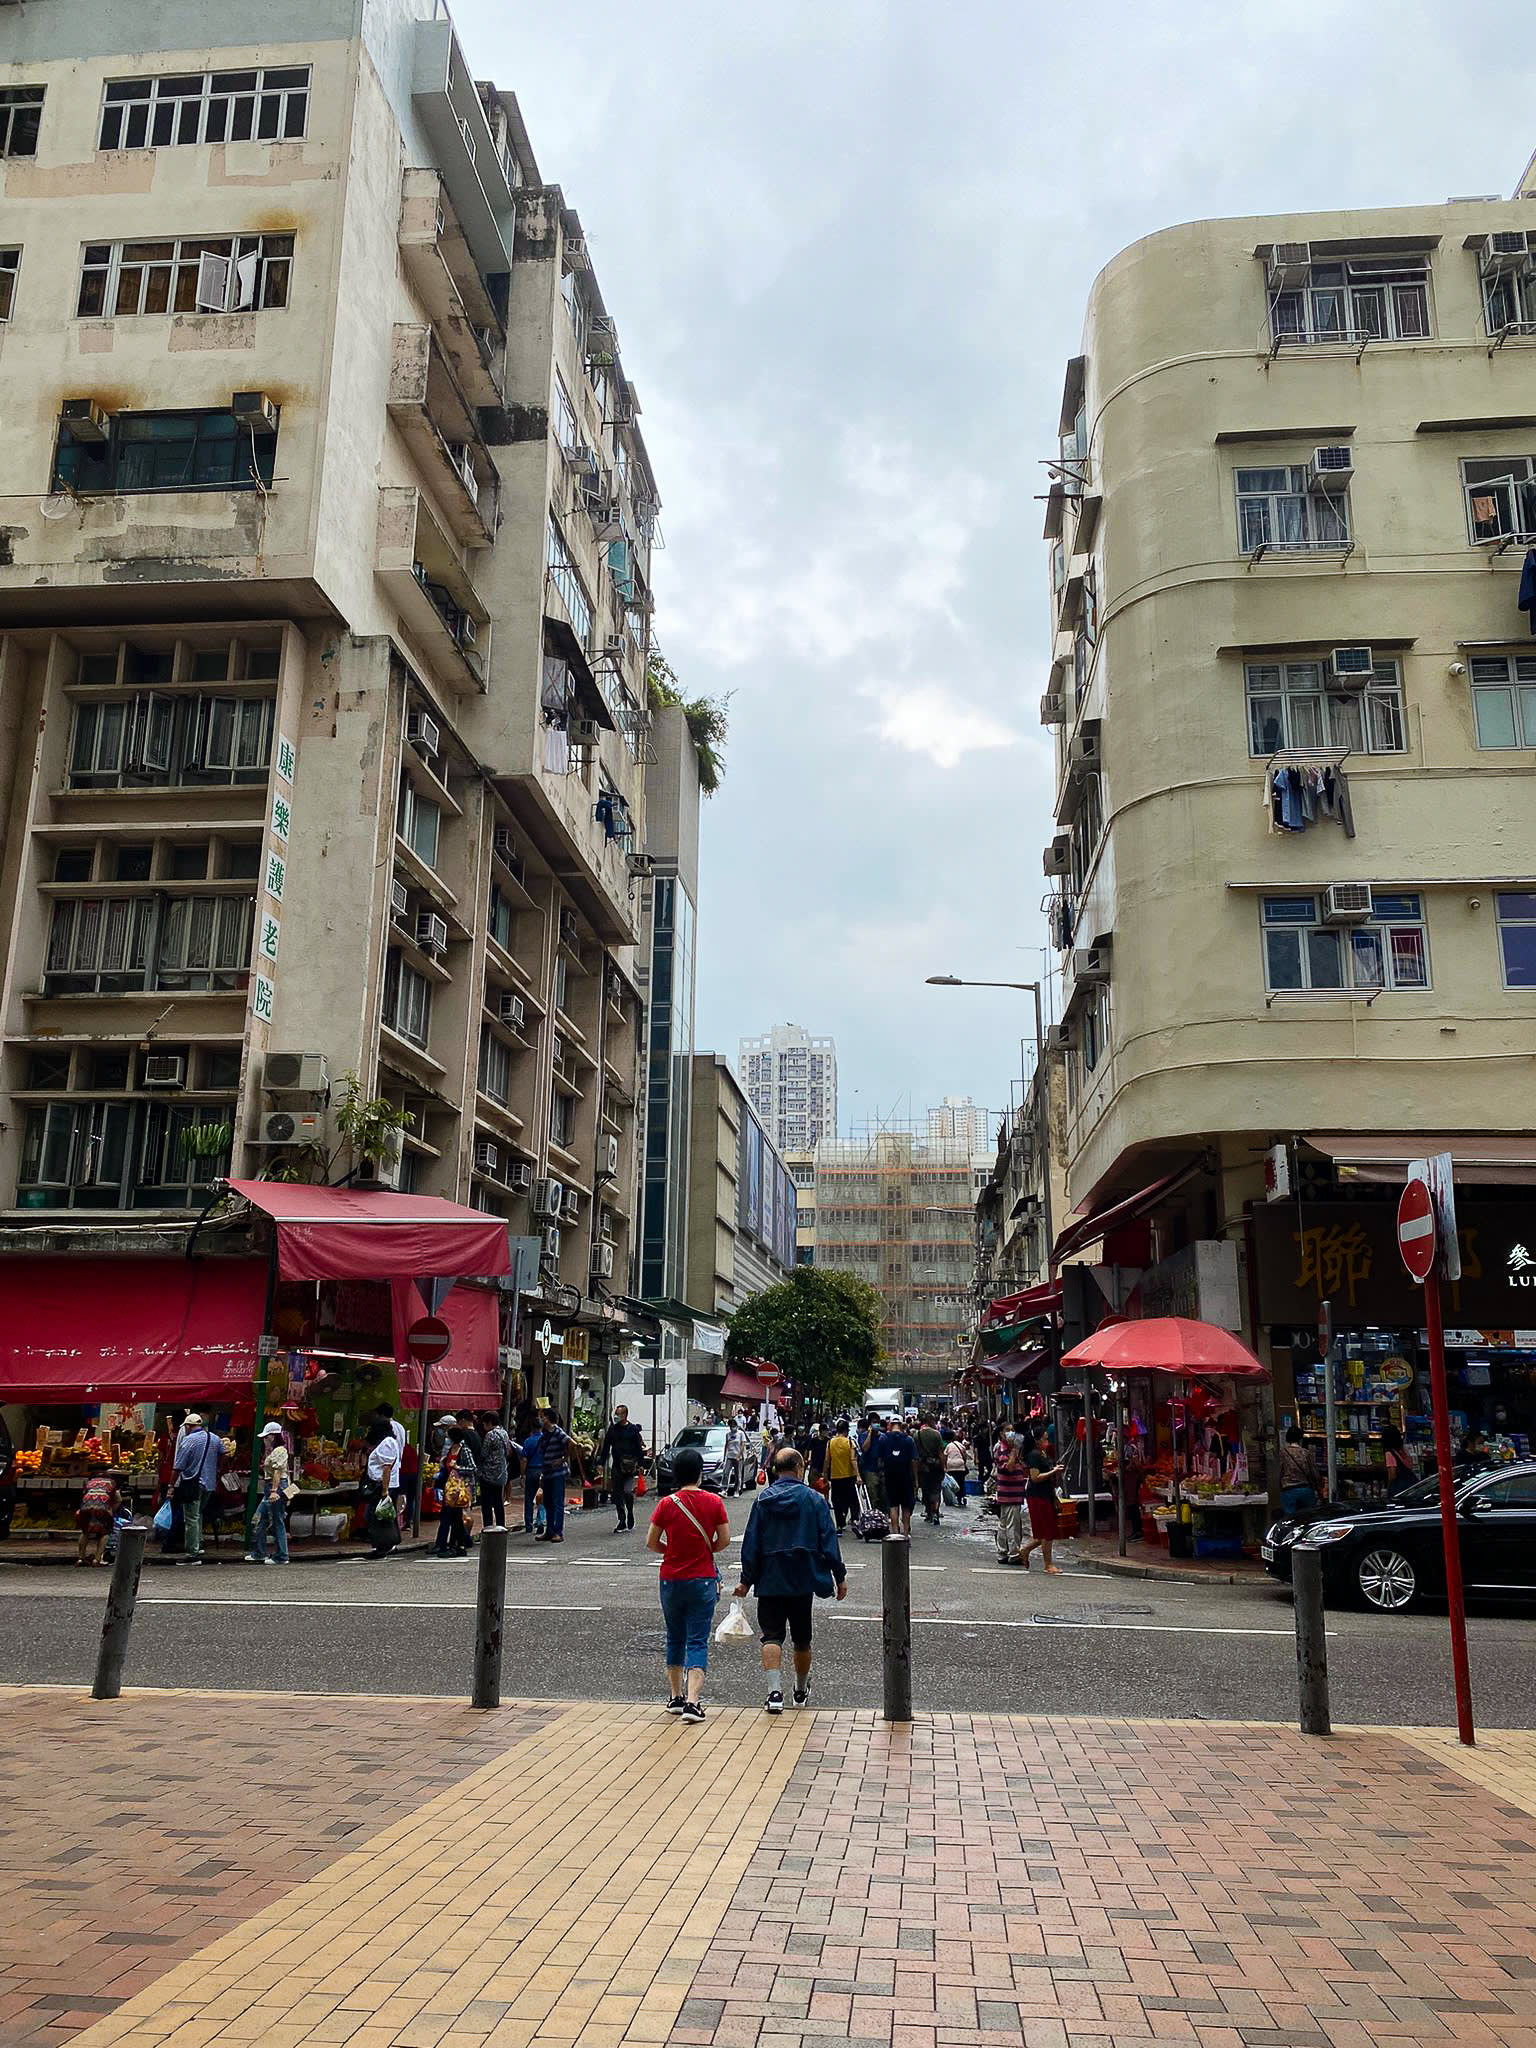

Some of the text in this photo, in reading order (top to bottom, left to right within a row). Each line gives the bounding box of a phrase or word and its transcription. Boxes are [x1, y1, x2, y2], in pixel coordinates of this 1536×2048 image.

[256, 740, 295, 1018] 康樂護老院
